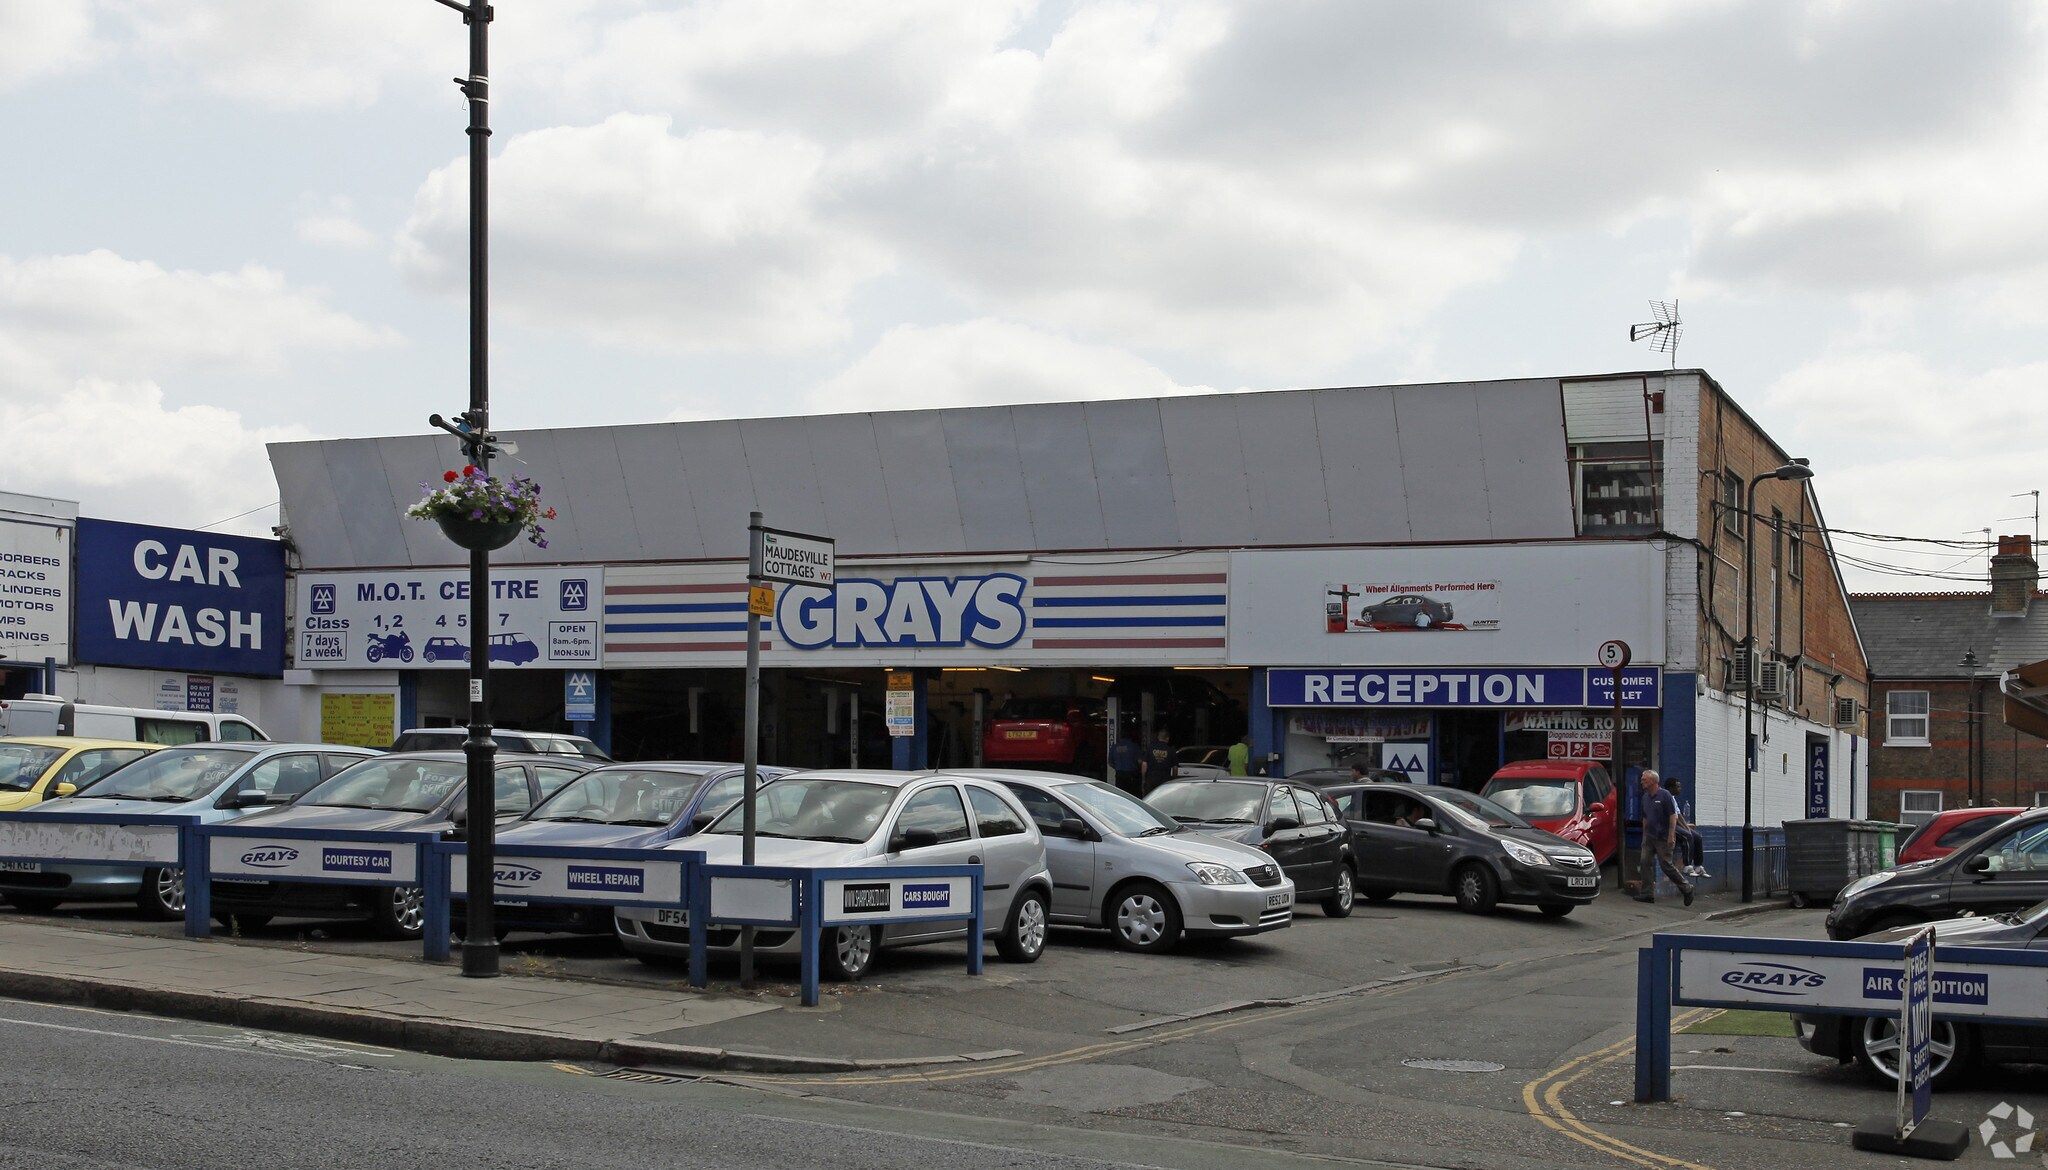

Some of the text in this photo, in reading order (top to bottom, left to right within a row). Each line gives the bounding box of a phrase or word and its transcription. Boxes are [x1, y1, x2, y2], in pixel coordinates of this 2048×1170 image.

[0, 553, 60, 566] ORBERS
[765, 545, 828, 566] MAUDESVILLE
[134, 539, 242, 588] CAR
[765, 561, 831, 580] COTTAGES W7
[0, 584, 61, 597] LINDERS
[357, 580, 539, 601] M.O.T. CETRE
[1366, 582, 1495, 595] Wheel Alignments Performed Here
[777, 573, 1027, 649] GRAYS
[109, 599, 262, 649] WASH
[305, 617, 350, 630] Class
[499, 613, 509, 626] 7
[559, 625, 586, 633] OPEN
[306, 635, 340, 649] 7 days
[305, 646, 343, 658] a week
[1606, 645, 1616, 659] 5
[1304, 674, 1545, 703] RECEPTION
[1592, 677, 1653, 686] CUSOMER
[1603, 691, 1642, 700] TOLET
[1523, 716, 1589, 730] WAITING
[1549, 731, 1579, 741] Diagnostic
[1580, 731, 1598, 739] check
[1814, 746, 1824, 804] PARTS
[241, 849, 300, 864] GRAYS
[325, 854, 390, 867] COURTESY CAR
[493, 871, 543, 881] RAYS
[569, 872, 640, 886] WHEEL REPAIR
[903, 890, 949, 902] CARS BOUGHT
[658, 909, 688, 925] DF54
[1910, 950, 1927, 978] FREE
[1721, 971, 1827, 988] GRAYS
[1913, 976, 1927, 997] PRE
[1866, 977, 1985, 997] AIR CDITION
[1912, 998, 1929, 1048] MOT
